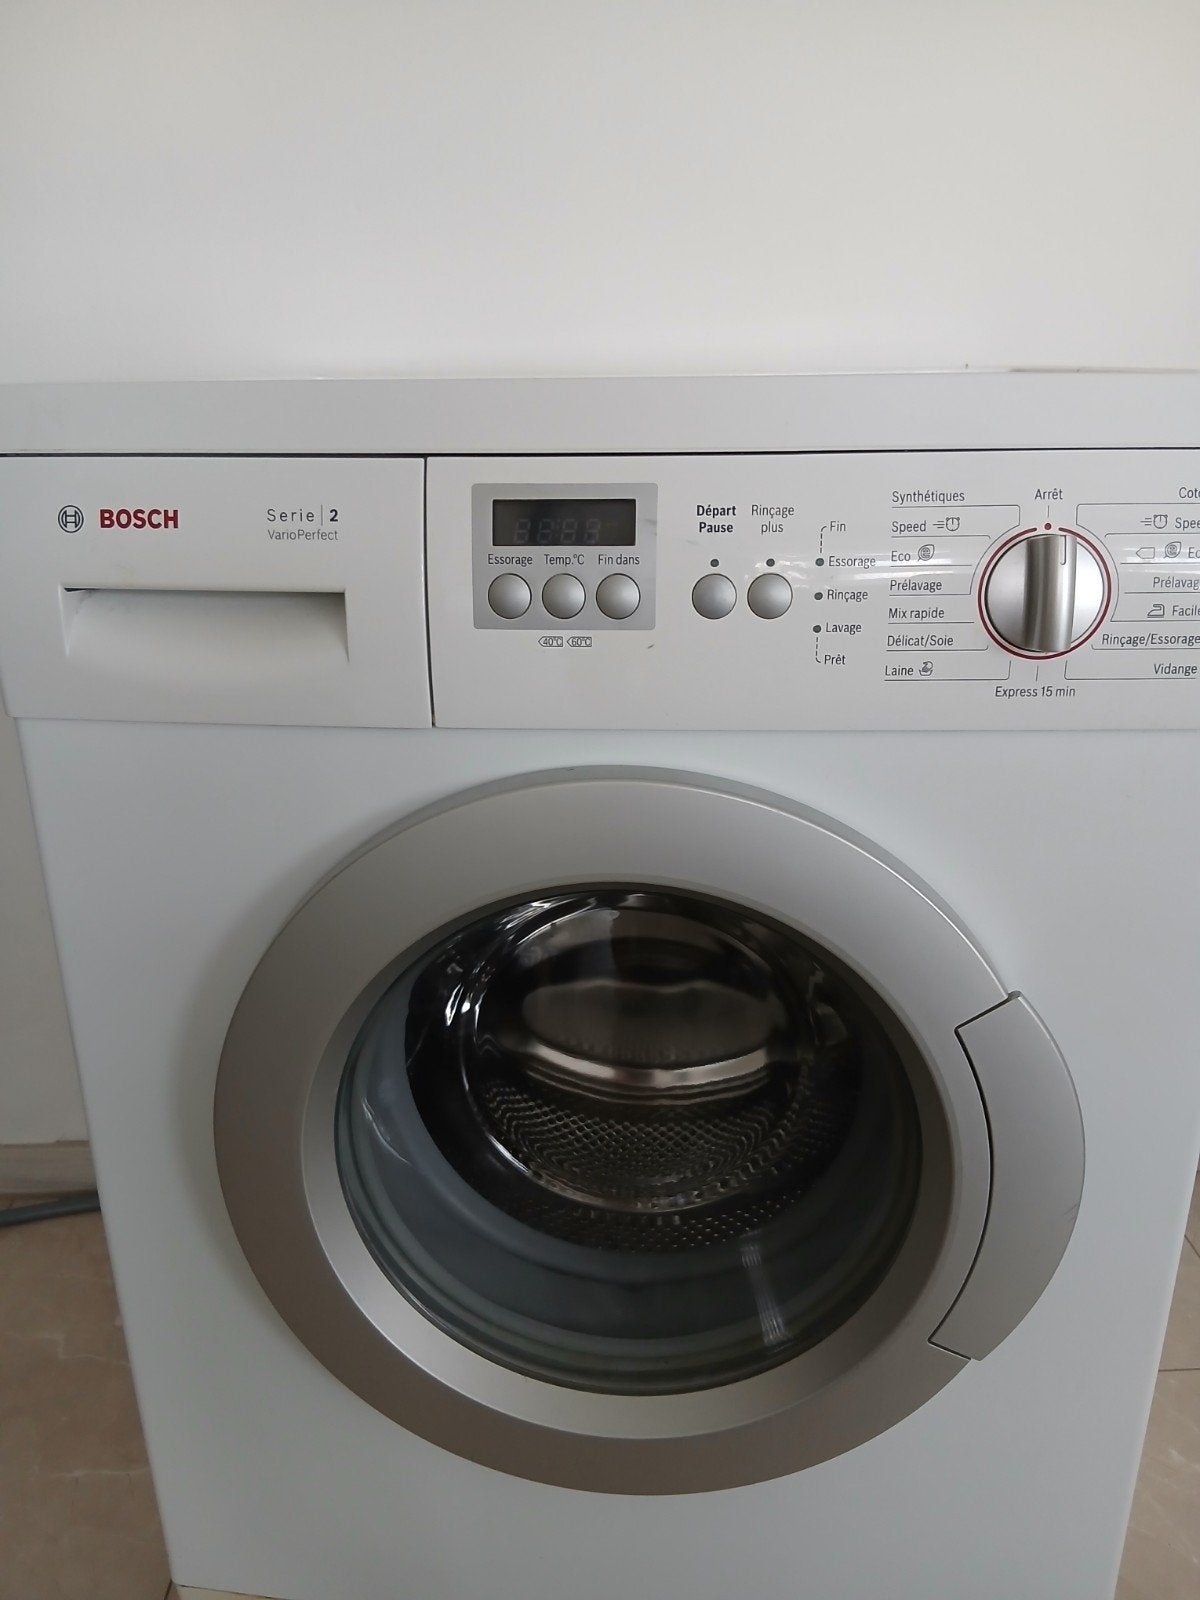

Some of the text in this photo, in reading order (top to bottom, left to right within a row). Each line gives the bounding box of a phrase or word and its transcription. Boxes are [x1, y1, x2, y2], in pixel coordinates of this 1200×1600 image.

[892, 490, 965, 505] Synthétiques
[1035, 488, 1063, 500] Arrêt
[267, 508, 339, 522] Serie 2
[696, 505, 737, 519] Départ
[751, 505, 795, 519] Rinçage
[100, 509, 179, 530] BOSCH
[699, 522, 734, 533] Pause
[761, 522, 784, 535] plus
[830, 521, 846, 532] Fin
[891, 521, 927, 535] Speed
[267, 529, 339, 541] VarioPerfect
[488, 554, 533, 567] Essorage
[598, 554, 640, 565] Fin dans
[828, 556, 876, 569] Essorage
[891, 551, 911, 562] Eco
[890, 579, 943, 593] Prélavage
[827, 589, 869, 603] Rinçage
[888, 607, 945, 621] Mix rapide
[825, 622, 862, 635] Lavage
[887, 635, 954, 647] Délicat/Soie
[1102, 633, 1200, 647] Rinçage/Essorage
[824, 654, 846, 665] Prêt
[884, 665, 914, 676] Laine
[1153, 663, 1198, 677] Vidange
[995, 686, 1076, 699] Express 15 min
